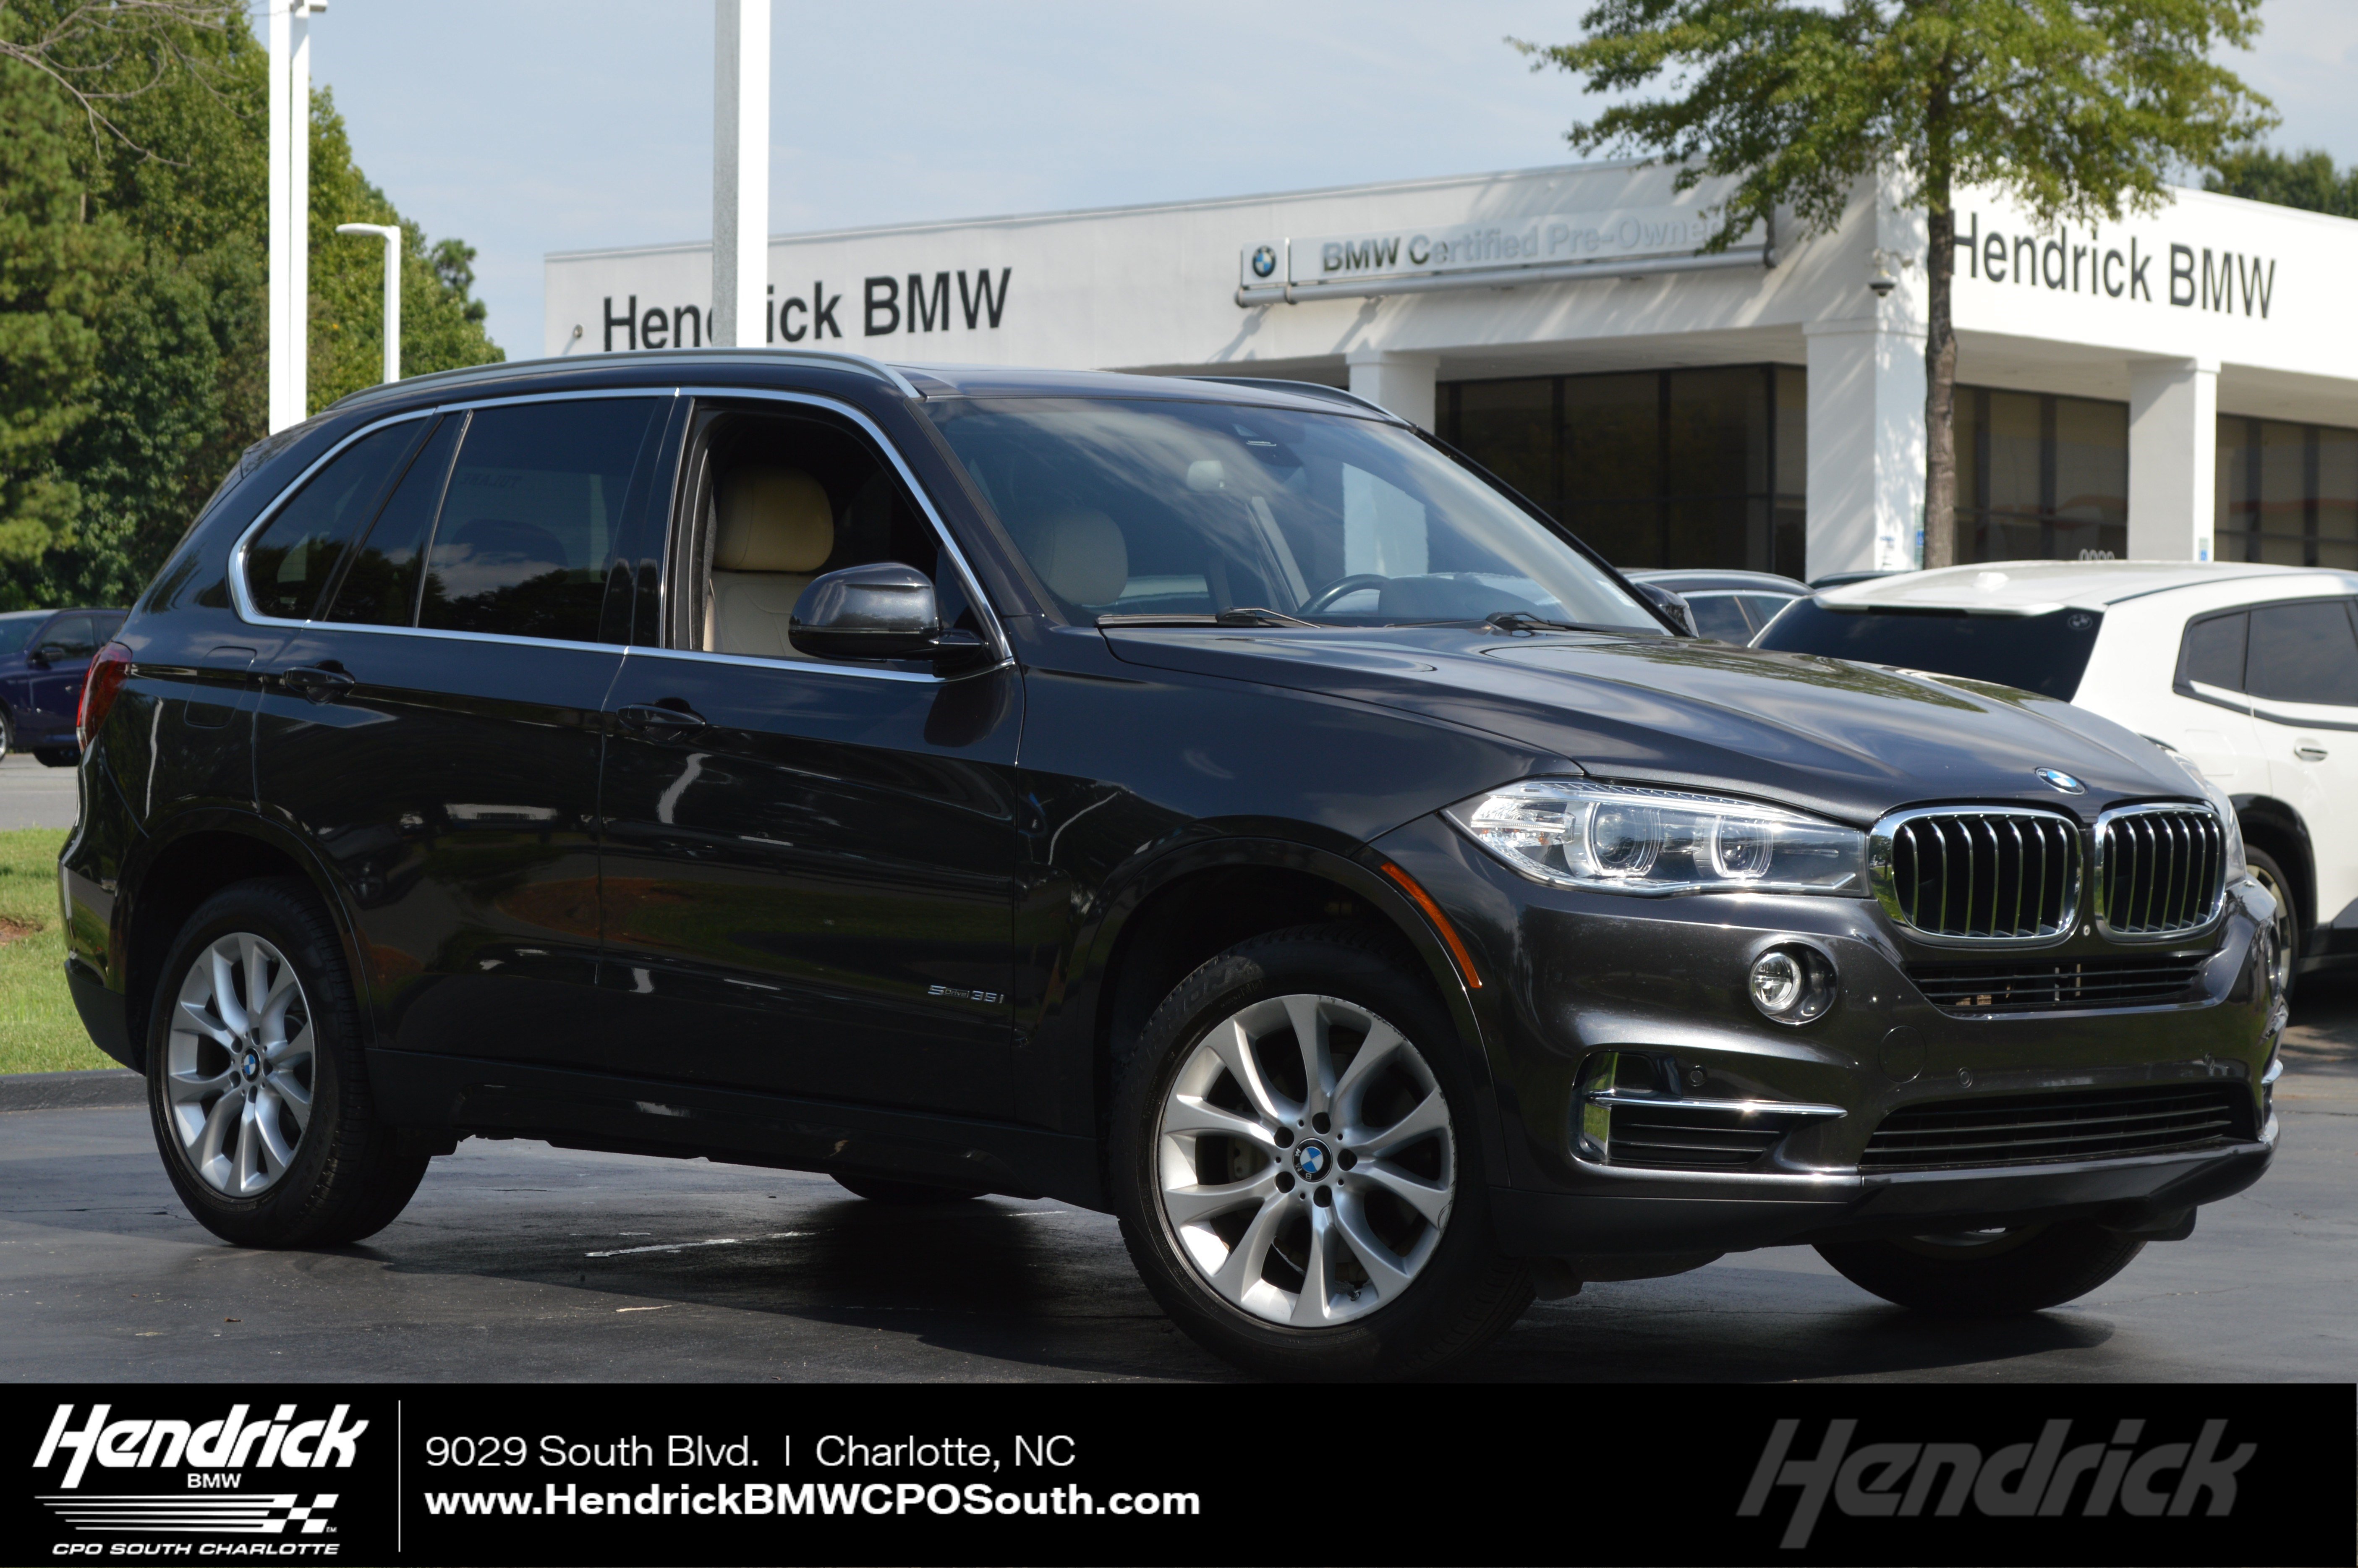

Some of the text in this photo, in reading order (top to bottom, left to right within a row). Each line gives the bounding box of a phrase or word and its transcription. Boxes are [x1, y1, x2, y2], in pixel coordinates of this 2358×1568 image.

[1322, 237, 1401, 272] BMW
[1407, 225, 1538, 265] Certified
[1950, 209, 2276, 319] Hendrick BMW
[604, 267, 1012, 352] Henick BMW
